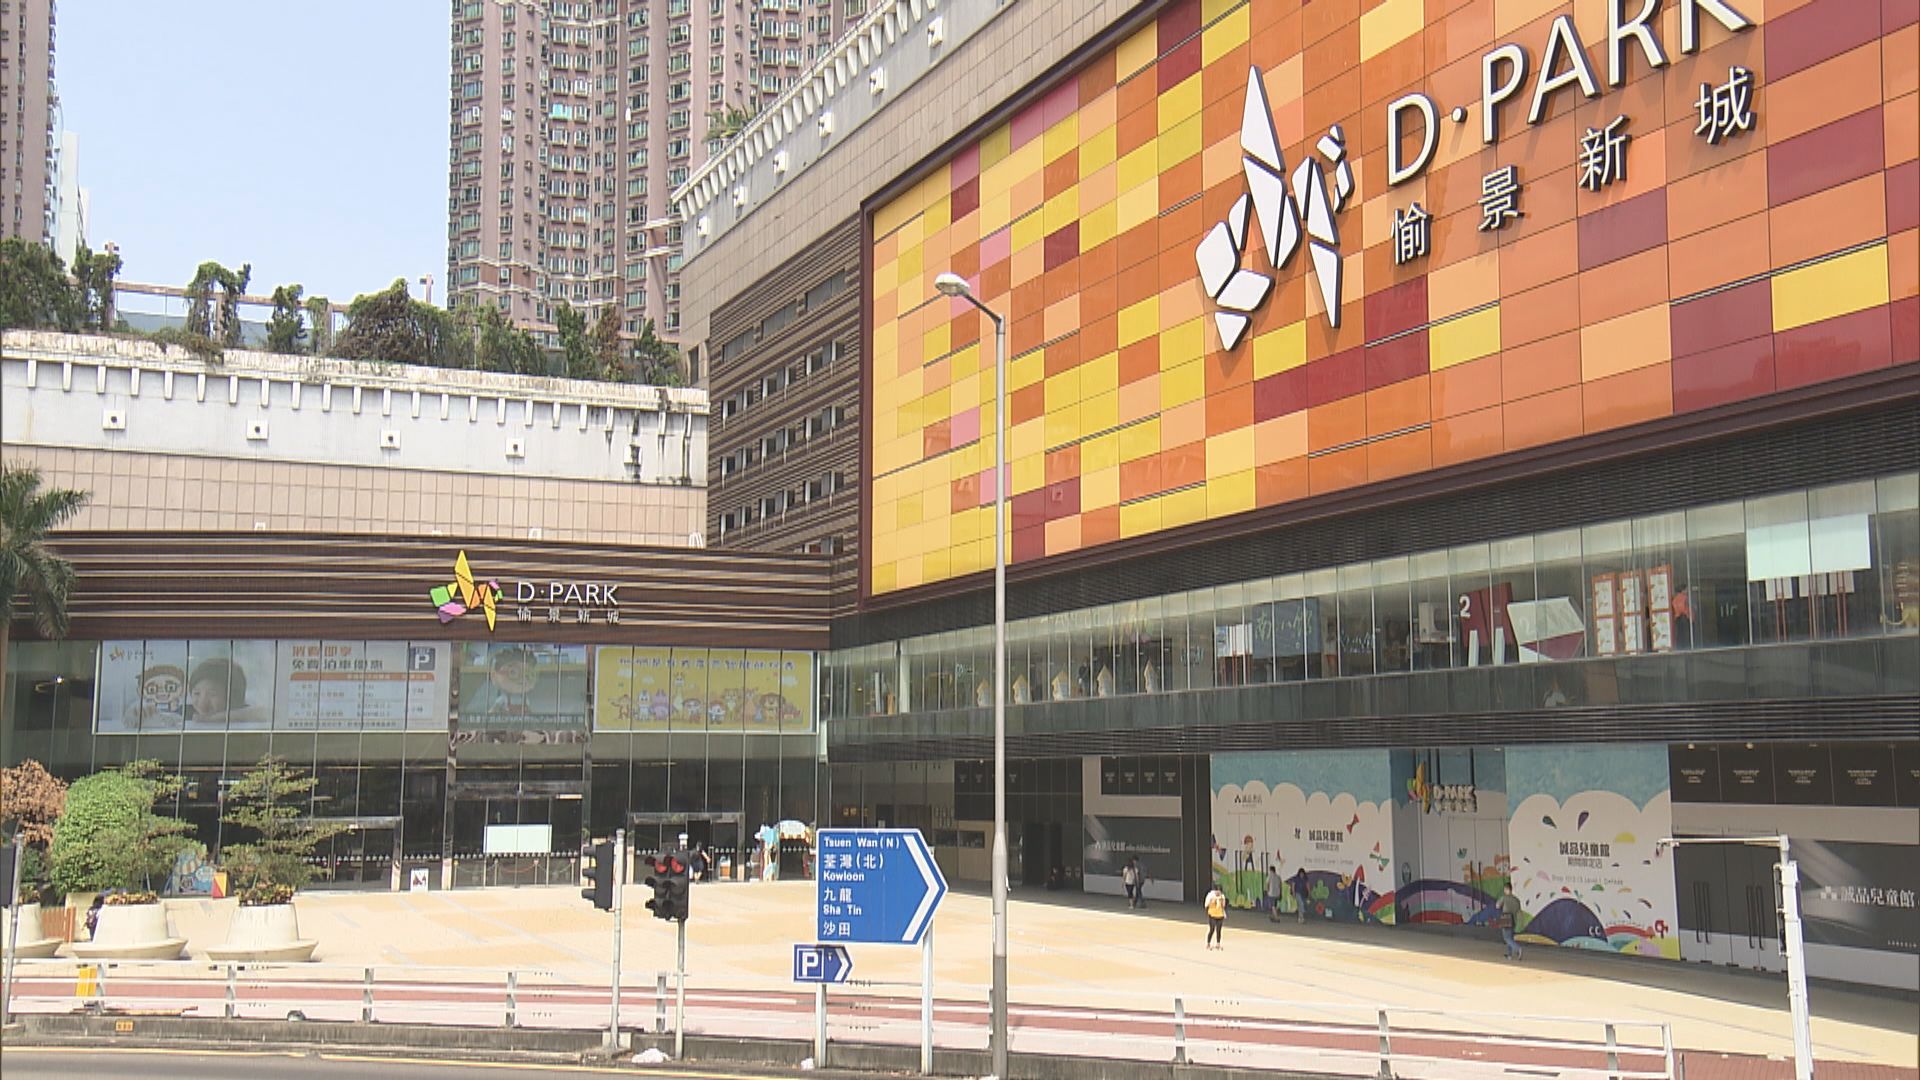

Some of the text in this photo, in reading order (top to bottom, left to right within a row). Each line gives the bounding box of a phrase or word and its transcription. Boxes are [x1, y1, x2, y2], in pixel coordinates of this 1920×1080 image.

[1391, 66, 1753, 265] 愉景新城
[517, 581, 618, 605] D·PARK
[1460, 596, 1471, 617] 2
[823, 838, 851, 847] Tsuen
[823, 870, 864, 881] Kowloon
[823, 887, 852, 903] 九龍
[823, 905, 862, 915] Sha Tin
[823, 921, 850, 936] 沙田
[802, 952, 818, 976] P
